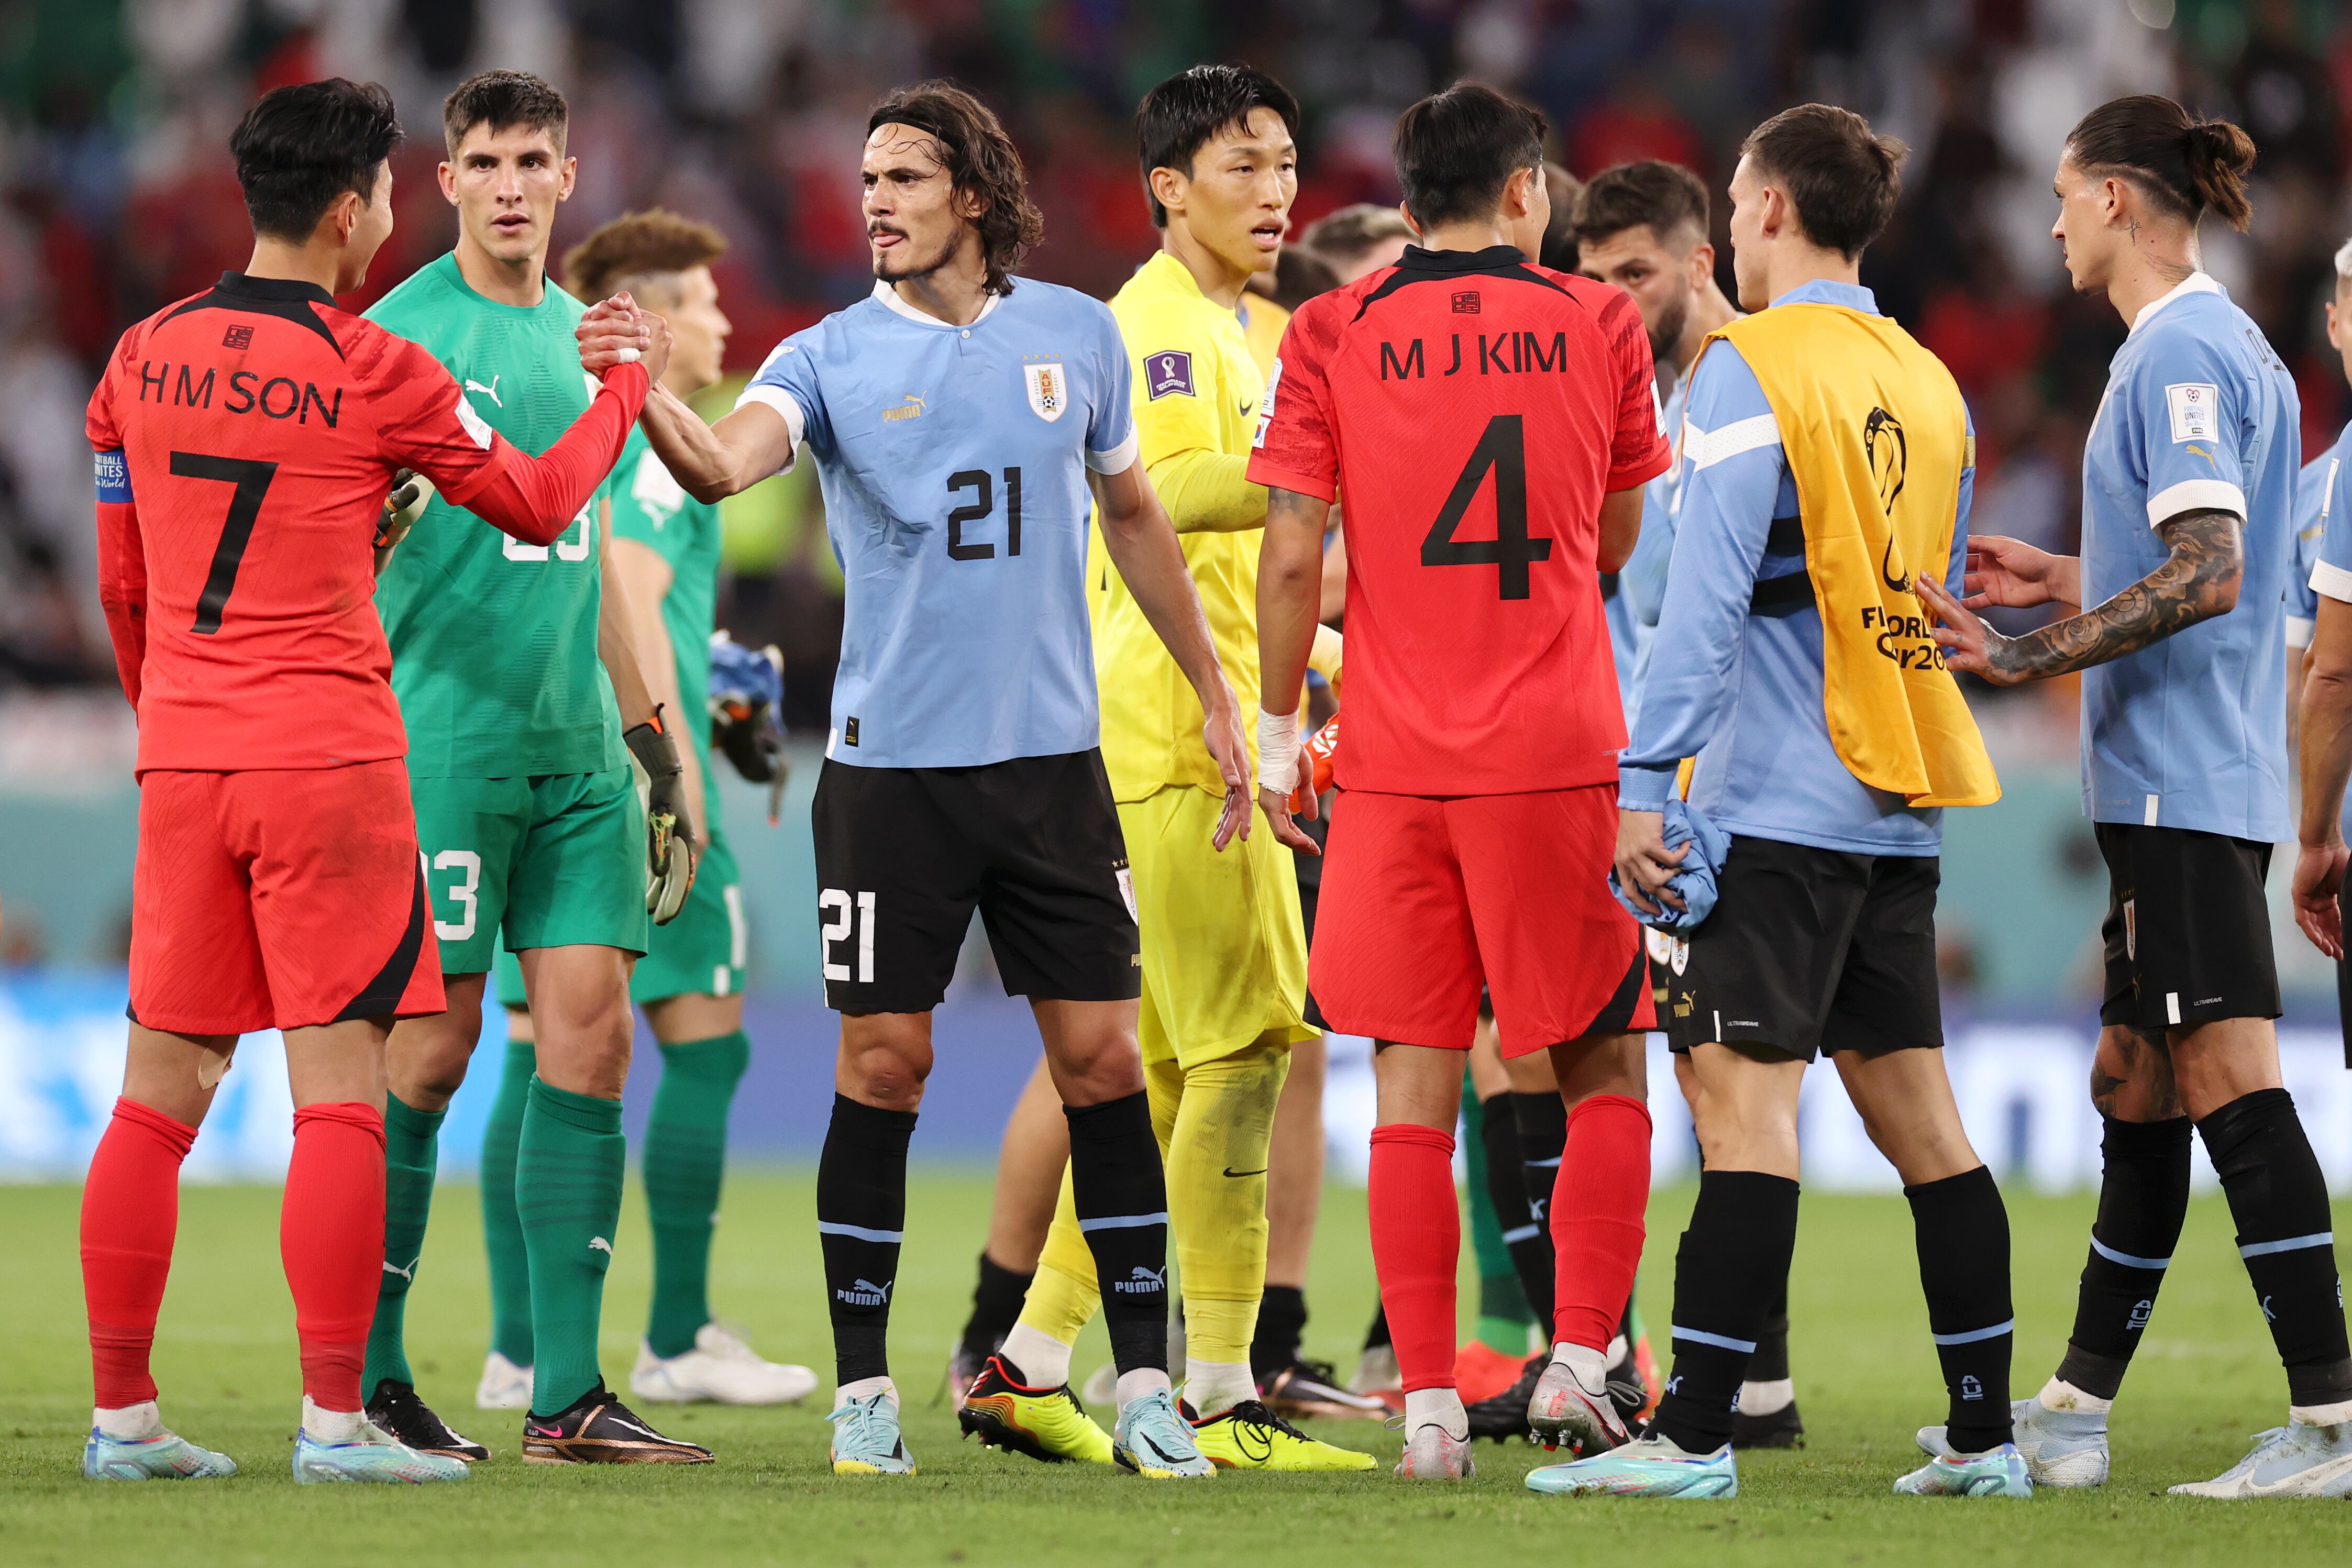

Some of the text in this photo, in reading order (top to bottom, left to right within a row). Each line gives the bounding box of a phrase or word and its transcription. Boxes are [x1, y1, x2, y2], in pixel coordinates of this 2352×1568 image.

[1381, 332, 1567, 380] M J KIM
[225, 371, 342, 428] SON
[882, 404, 920, 423] PUMA
[2185, 412, 2204, 421] UNITES
[101, 478, 125, 489] World
[947, 467, 1022, 561] 21
[1420, 414, 1553, 600] 4
[169, 451, 279, 635] 7
[1862, 606, 1930, 638] FI ORL
[419, 850, 481, 940] 3
[819, 888, 876, 982] 21
[1131, 953, 1141, 967] PU
[837, 1289, 880, 1306] PUMA
[1115, 1281, 1159, 1293] PUMA
[2126, 1300, 2151, 1330] AUF
[1962, 1375, 1983, 1400] AUF
